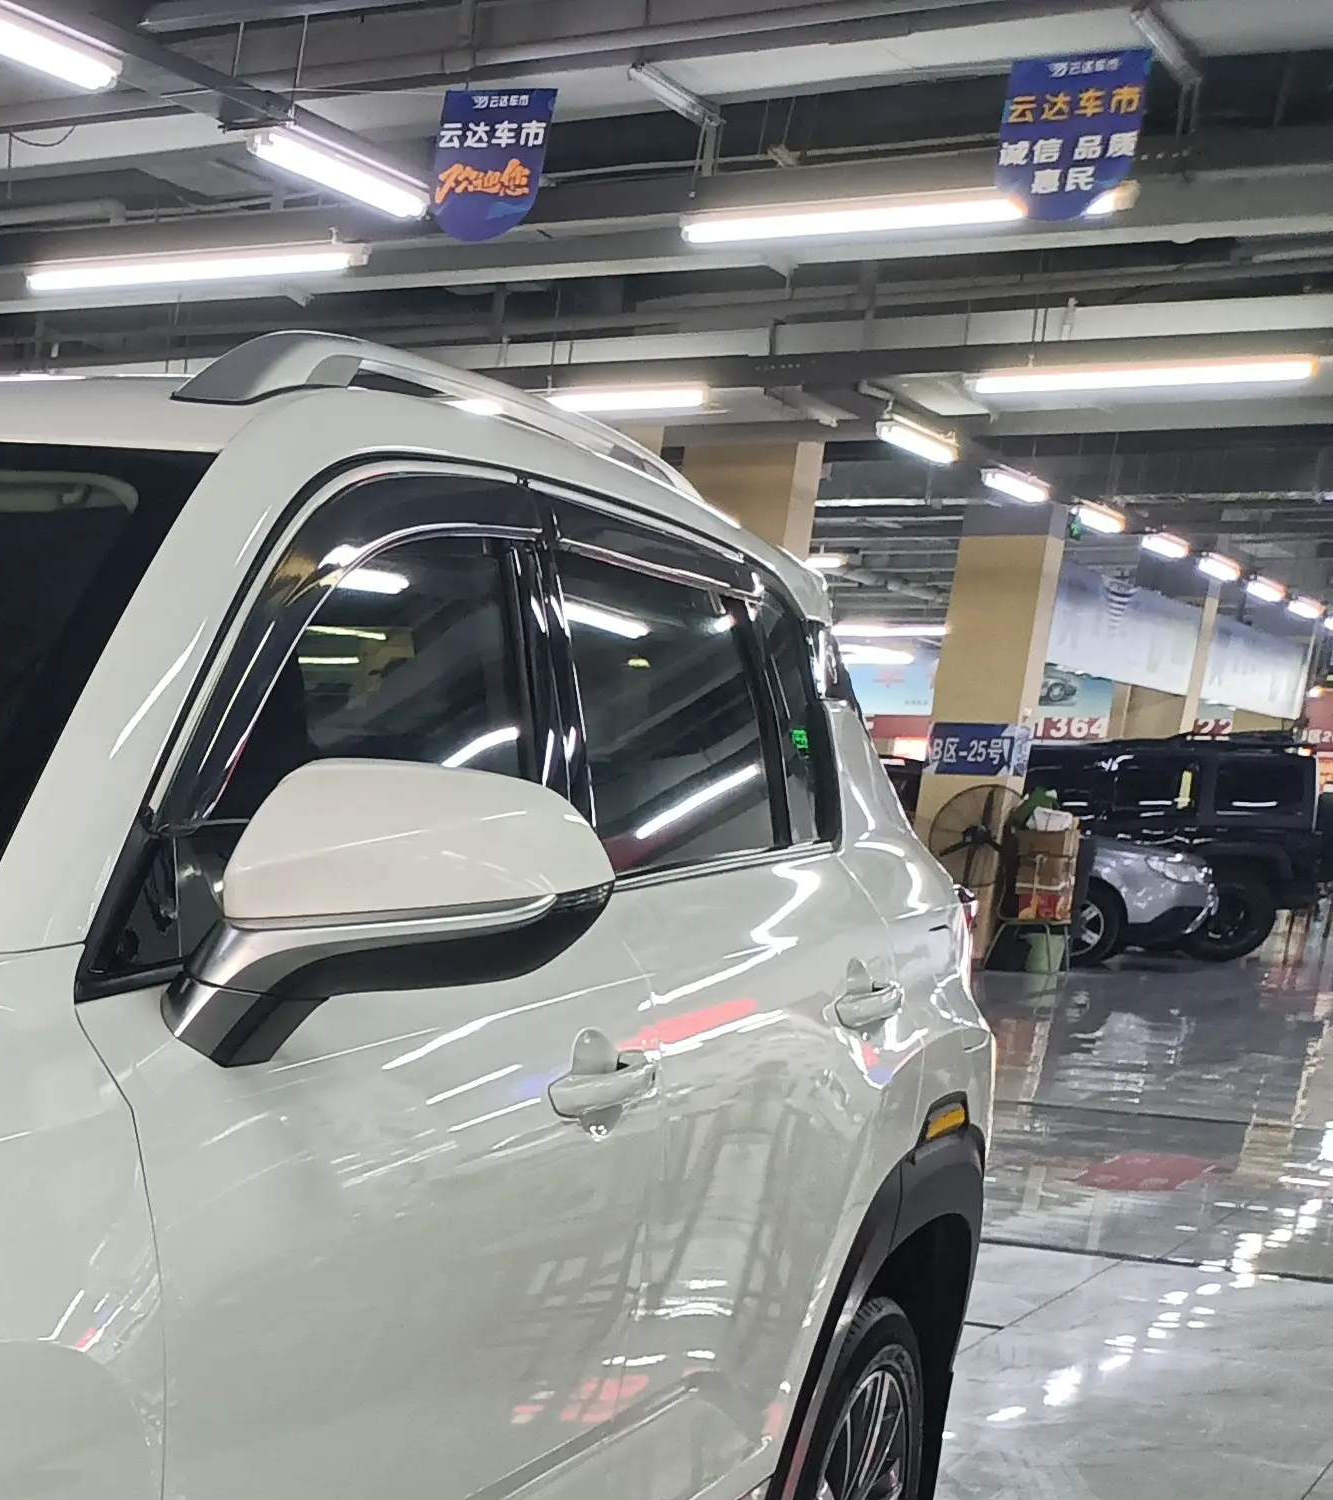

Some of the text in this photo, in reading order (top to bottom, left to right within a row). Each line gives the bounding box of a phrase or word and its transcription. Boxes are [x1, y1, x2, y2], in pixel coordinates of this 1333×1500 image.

[1007, 85, 1143, 124] 云达车市
[438, 120, 547, 148] 云达车市
[998, 130, 1141, 167] 诚信 品质
[435, 158, 531, 204] 欢迎您
[1030, 166, 1096, 194] 惠民
[933, 737, 1003, 765] B区-25号
